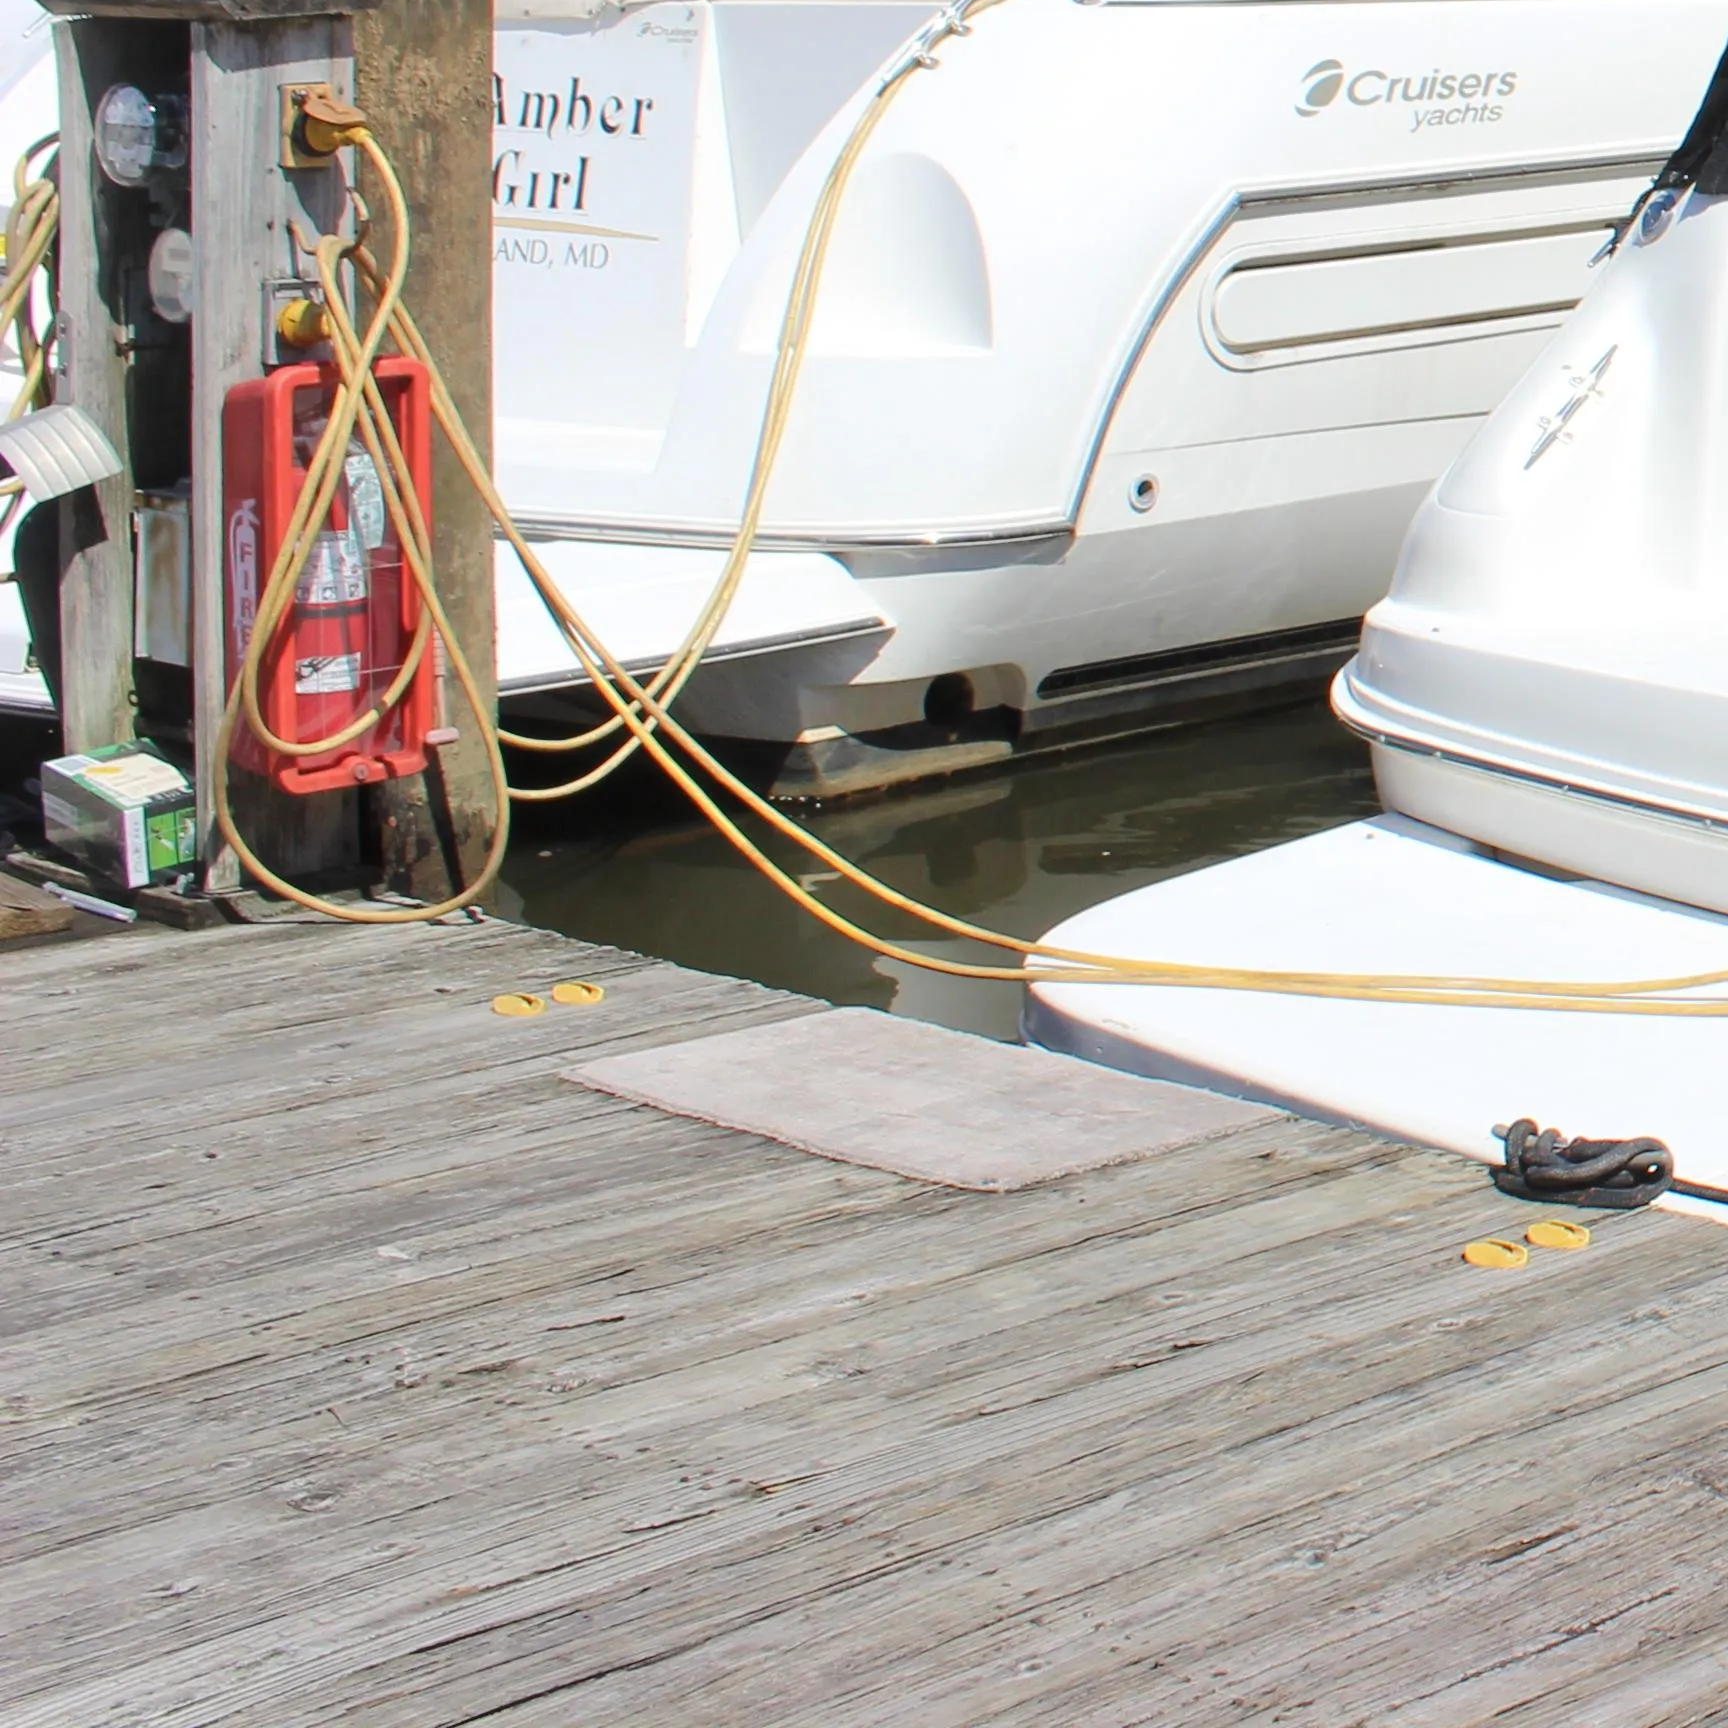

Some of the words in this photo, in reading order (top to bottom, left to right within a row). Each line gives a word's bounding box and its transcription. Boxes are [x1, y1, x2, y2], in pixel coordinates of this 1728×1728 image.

[1347, 68, 1518, 106] Cruisers
[1410, 102, 1504, 133] yachts
[492, 149, 590, 211] Girl
[493, 237, 554, 269] AND,
[564, 241, 610, 270] MD
[240, 541, 254, 646] FIRE
